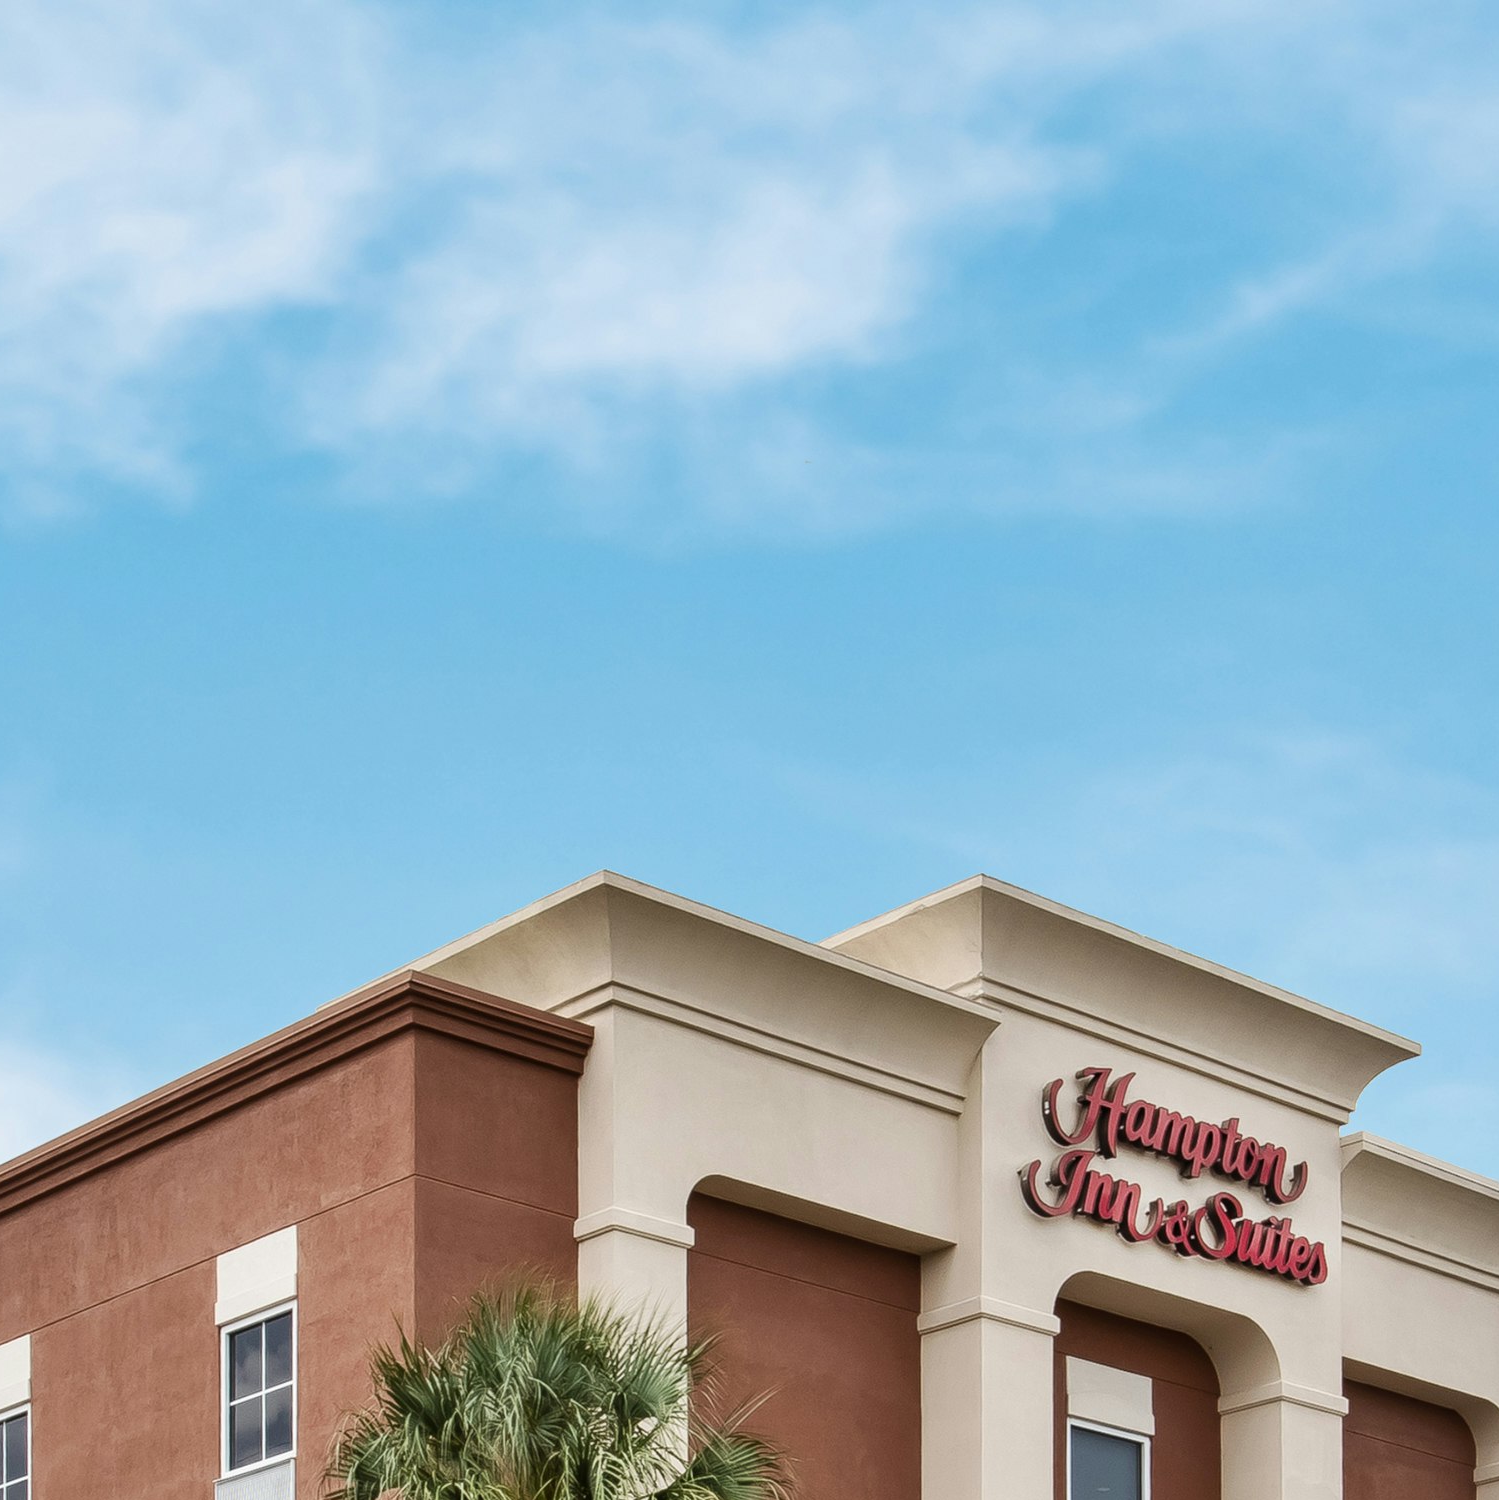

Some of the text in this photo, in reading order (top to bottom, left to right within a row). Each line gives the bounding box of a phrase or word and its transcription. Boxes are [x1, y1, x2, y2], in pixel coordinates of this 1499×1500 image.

[1042, 1067, 1308, 1206] Hampton
[1018, 1150, 1328, 1285] Inn & Suites
